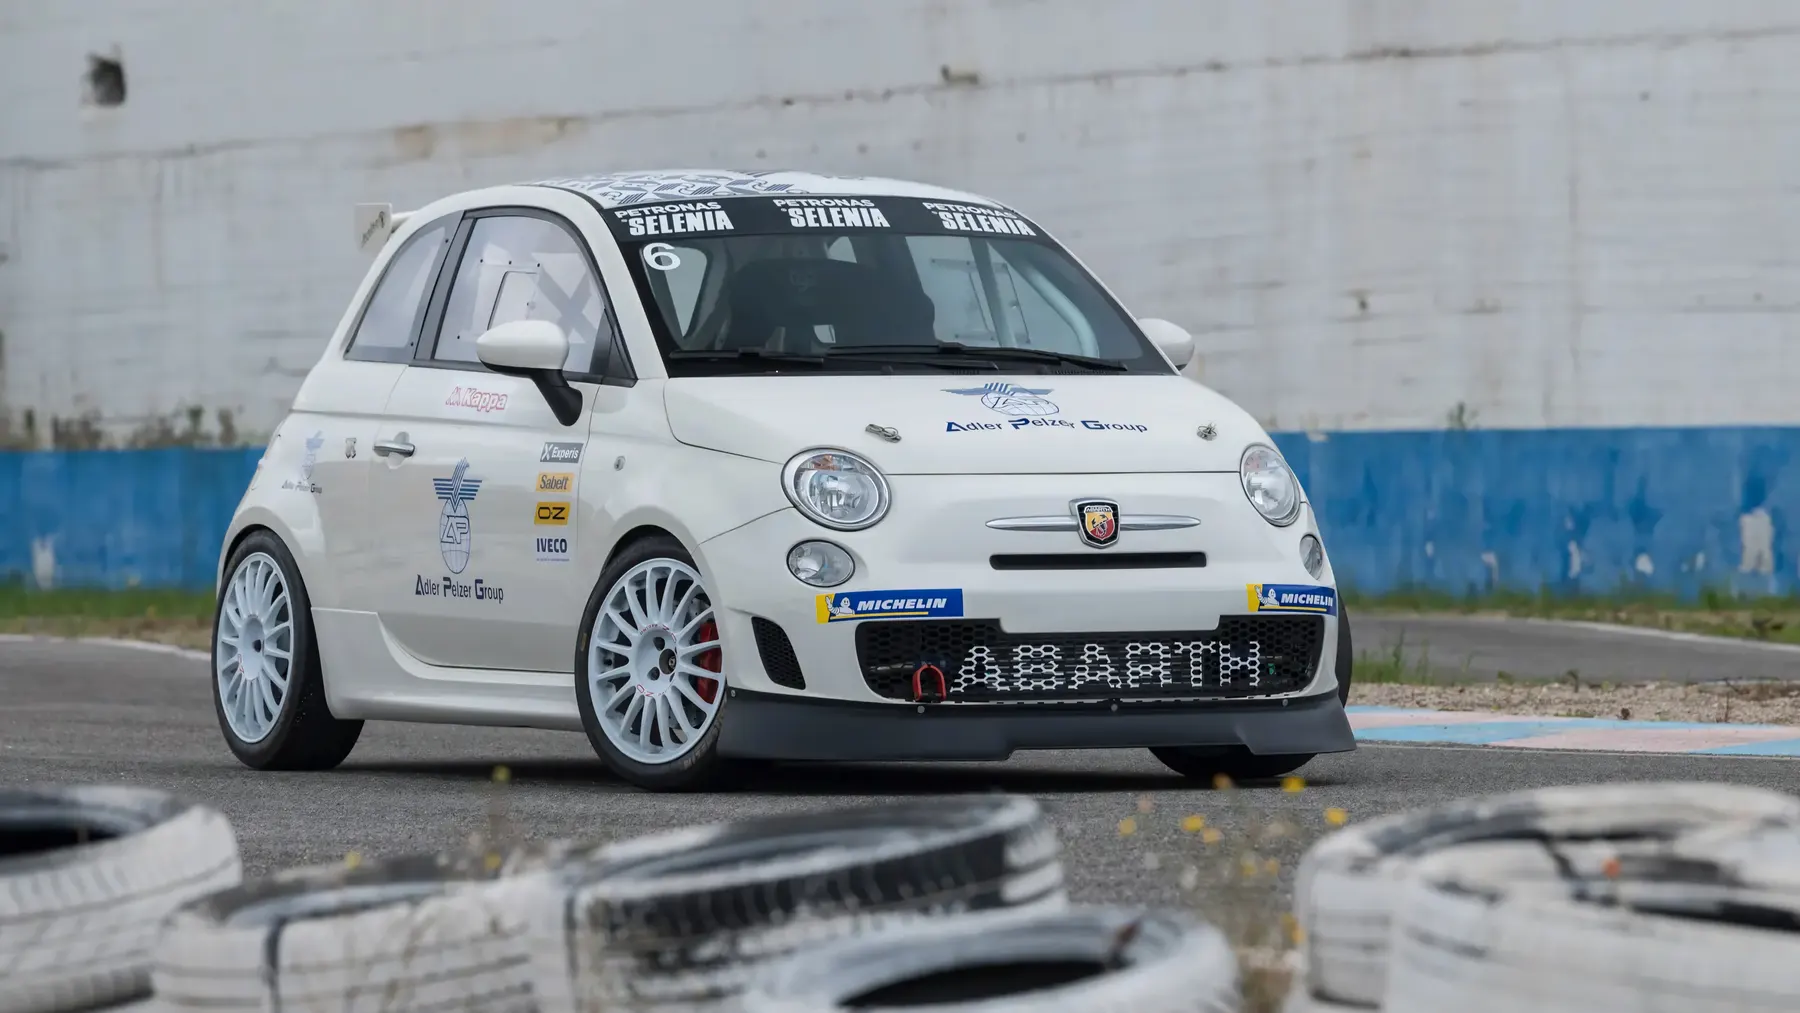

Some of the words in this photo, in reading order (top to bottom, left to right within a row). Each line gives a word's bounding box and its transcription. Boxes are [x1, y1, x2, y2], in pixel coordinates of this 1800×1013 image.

[614, 201, 722, 219] PETRONAS
[773, 198, 875, 207] PETRONAS
[922, 202, 1017, 219] PETRONAS
[628, 210, 734, 236] SELENIA
[788, 207, 891, 228] SELENIA
[938, 210, 1037, 236] SELENIA
[642, 242, 681, 271] 6
[461, 387, 508, 412] Kappa
[946, 420, 1002, 432] Adler
[1008, 418, 1075, 430] Pelzer
[1081, 420, 1148, 433] Group
[551, 447, 579, 460] Experis
[536, 537, 568, 553] IVECO
[415, 574, 440, 596] Adler
[443, 576, 472, 598] Pelzer
[474, 579, 504, 604] Group
[857, 598, 947, 611] MICHELIN
[1280, 593, 1333, 607] MICHELIN
[950, 641, 1260, 692] ABARTH
